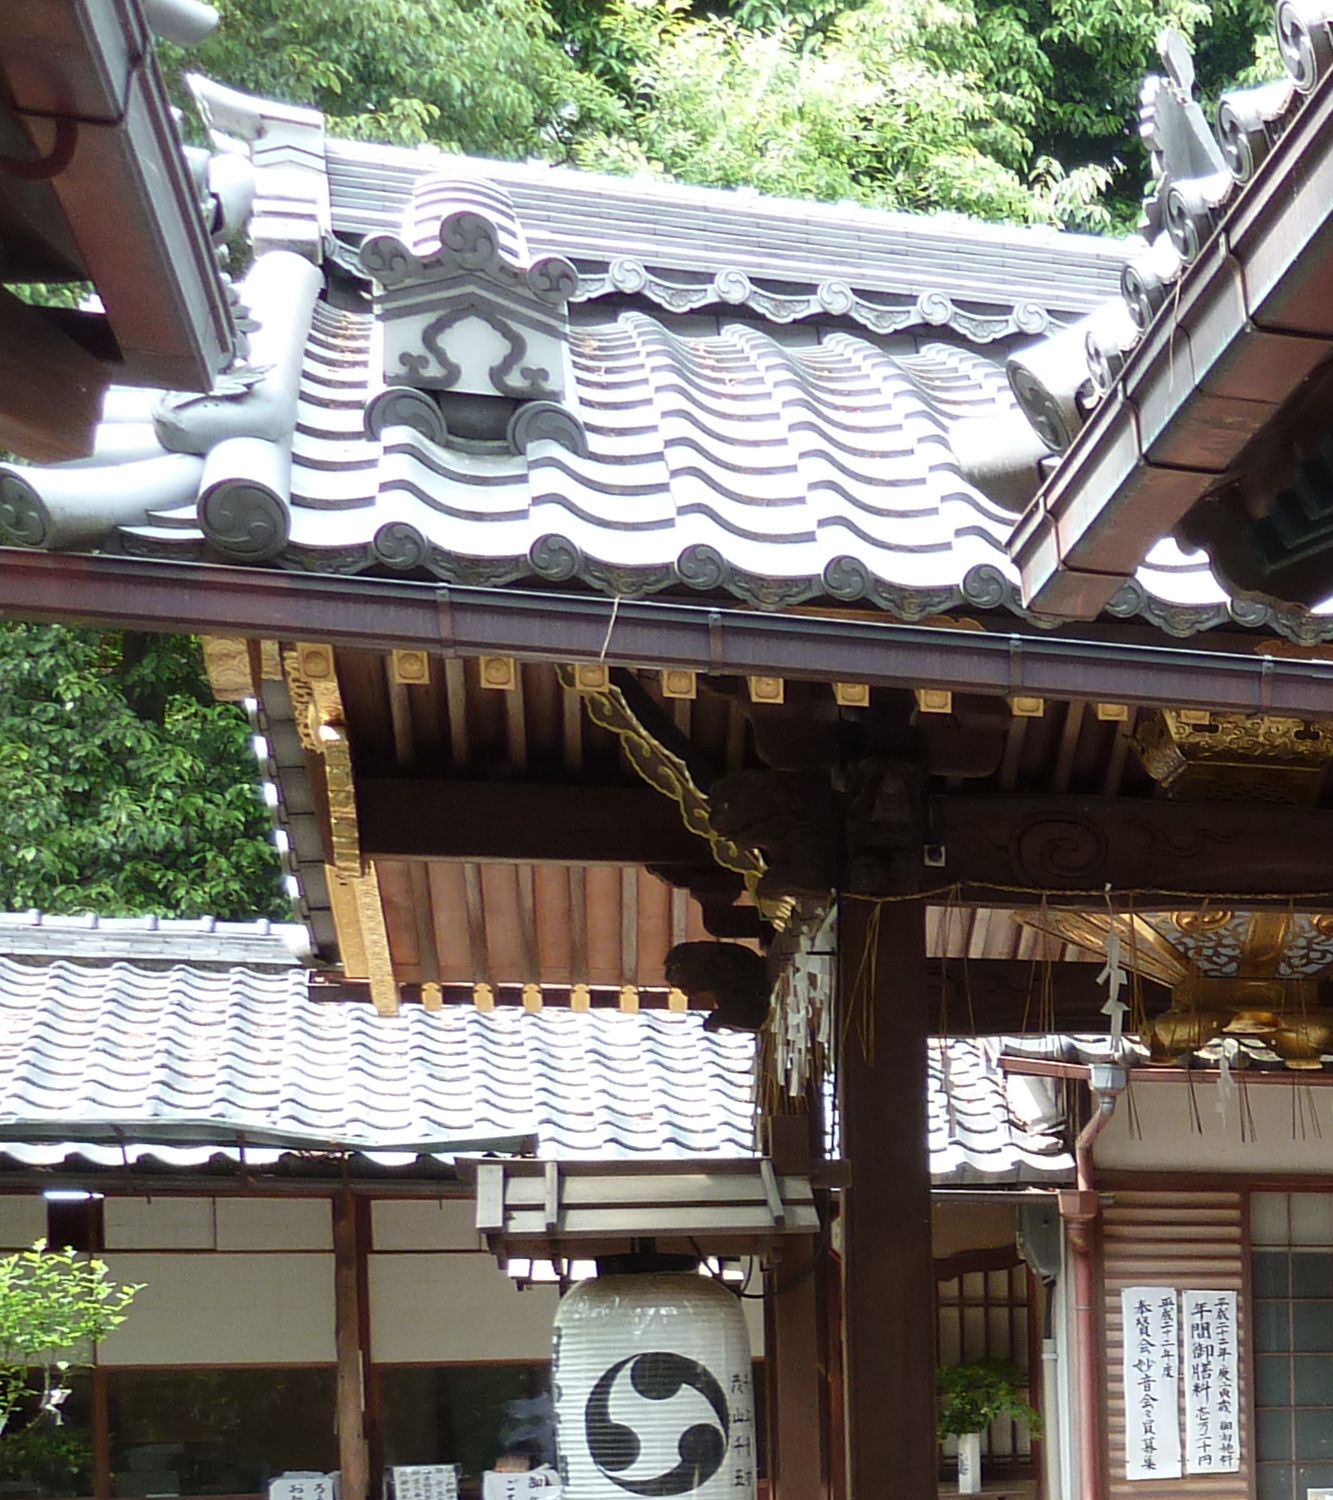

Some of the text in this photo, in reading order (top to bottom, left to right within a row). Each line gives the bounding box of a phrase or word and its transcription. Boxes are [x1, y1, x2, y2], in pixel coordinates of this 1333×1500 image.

[1157, 1296, 1176, 1379] 平成二十二年度
